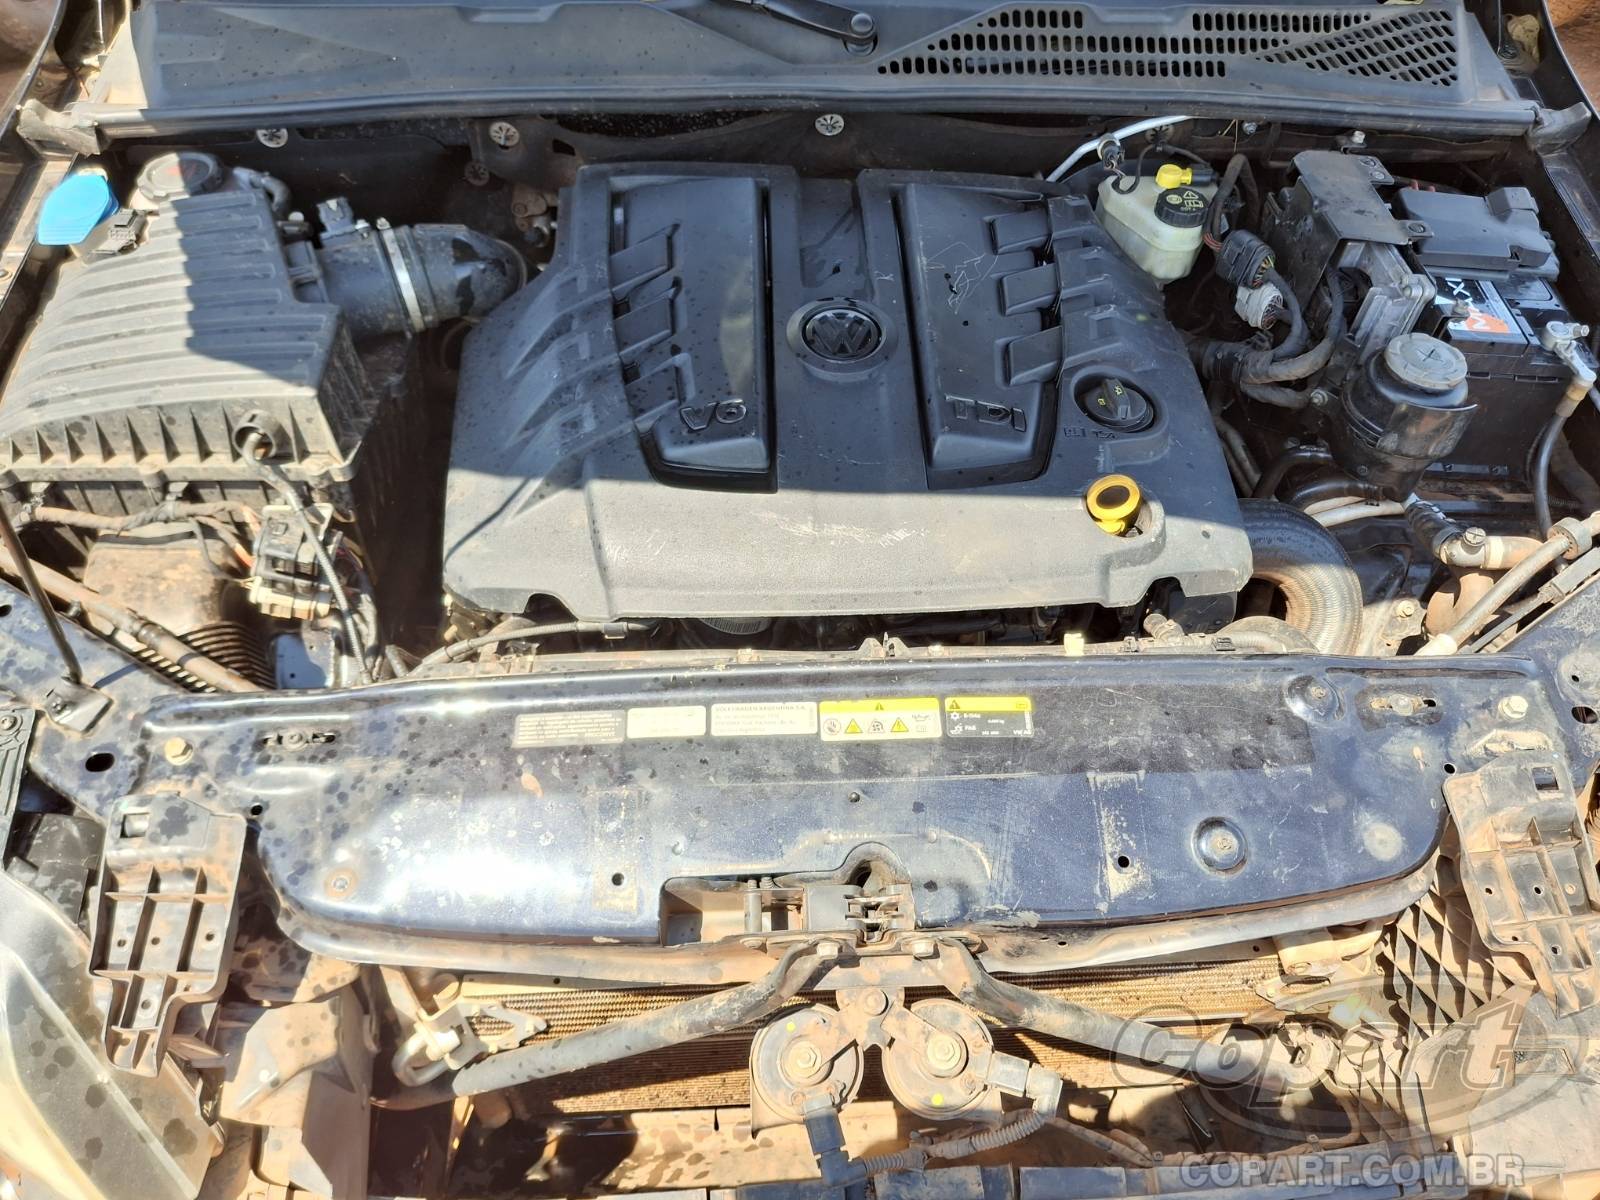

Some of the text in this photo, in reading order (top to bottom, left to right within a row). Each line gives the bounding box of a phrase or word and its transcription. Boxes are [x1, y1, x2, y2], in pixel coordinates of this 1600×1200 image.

[804, 308, 880, 359] VW
[679, 397, 747, 431] V6
[943, 393, 1027, 432] TDI
